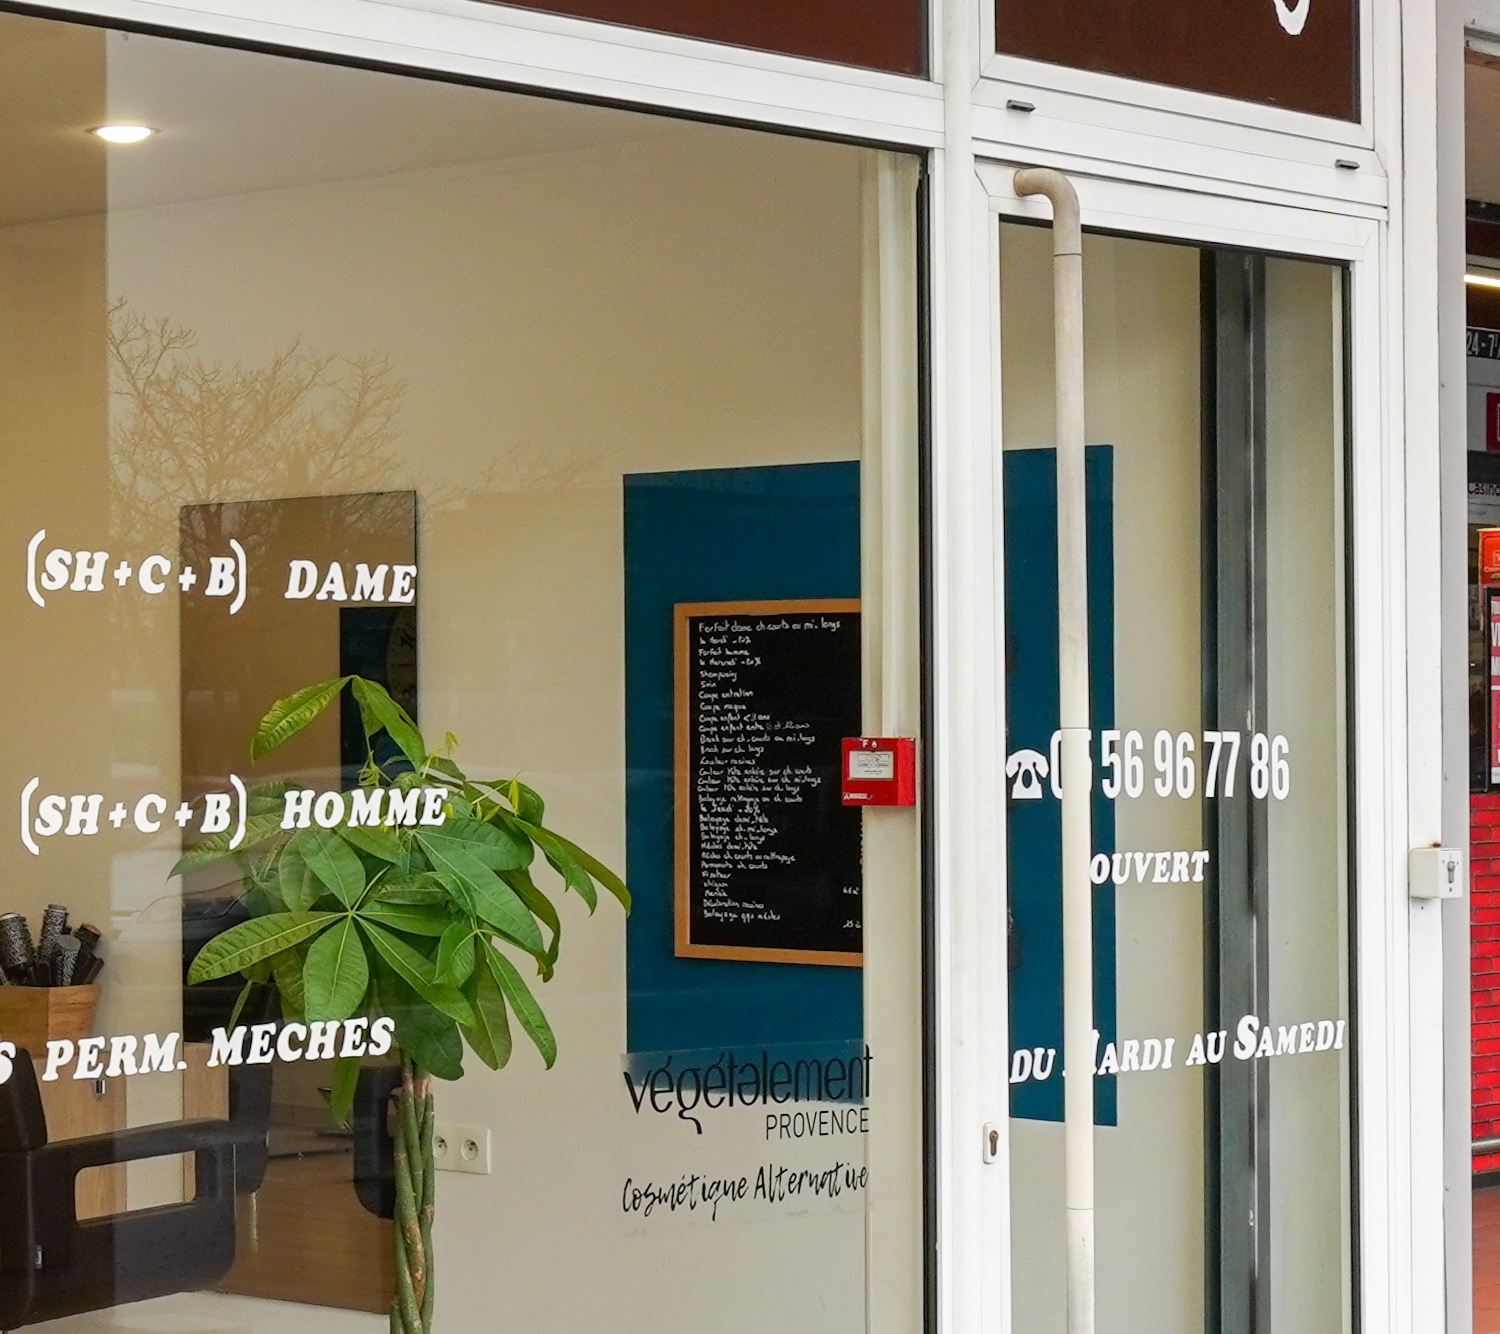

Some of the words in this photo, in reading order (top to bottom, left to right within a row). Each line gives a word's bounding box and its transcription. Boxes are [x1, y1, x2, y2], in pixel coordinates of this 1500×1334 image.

[284, 559, 417, 603] DAME
[1101, 729, 1144, 799] 56
[1154, 729, 1195, 799] 96
[1203, 731, 1241, 798] 77
[1250, 733, 1290, 800] 86
[280, 786, 449, 830] HOMME
[1089, 850, 1209, 884] OUVERT
[43, 1032, 188, 1084] PERM.
[207, 1017, 396, 1069] MECHES
[1009, 1047, 1056, 1084] DU
[1186, 1031, 1227, 1066] AU
[623, 1044, 873, 1135] végétalement
[766, 1108, 869, 1140] PROVENCE
[622, 1174, 750, 1222] Cosmétique
[753, 1161, 869, 1203] Alternative
